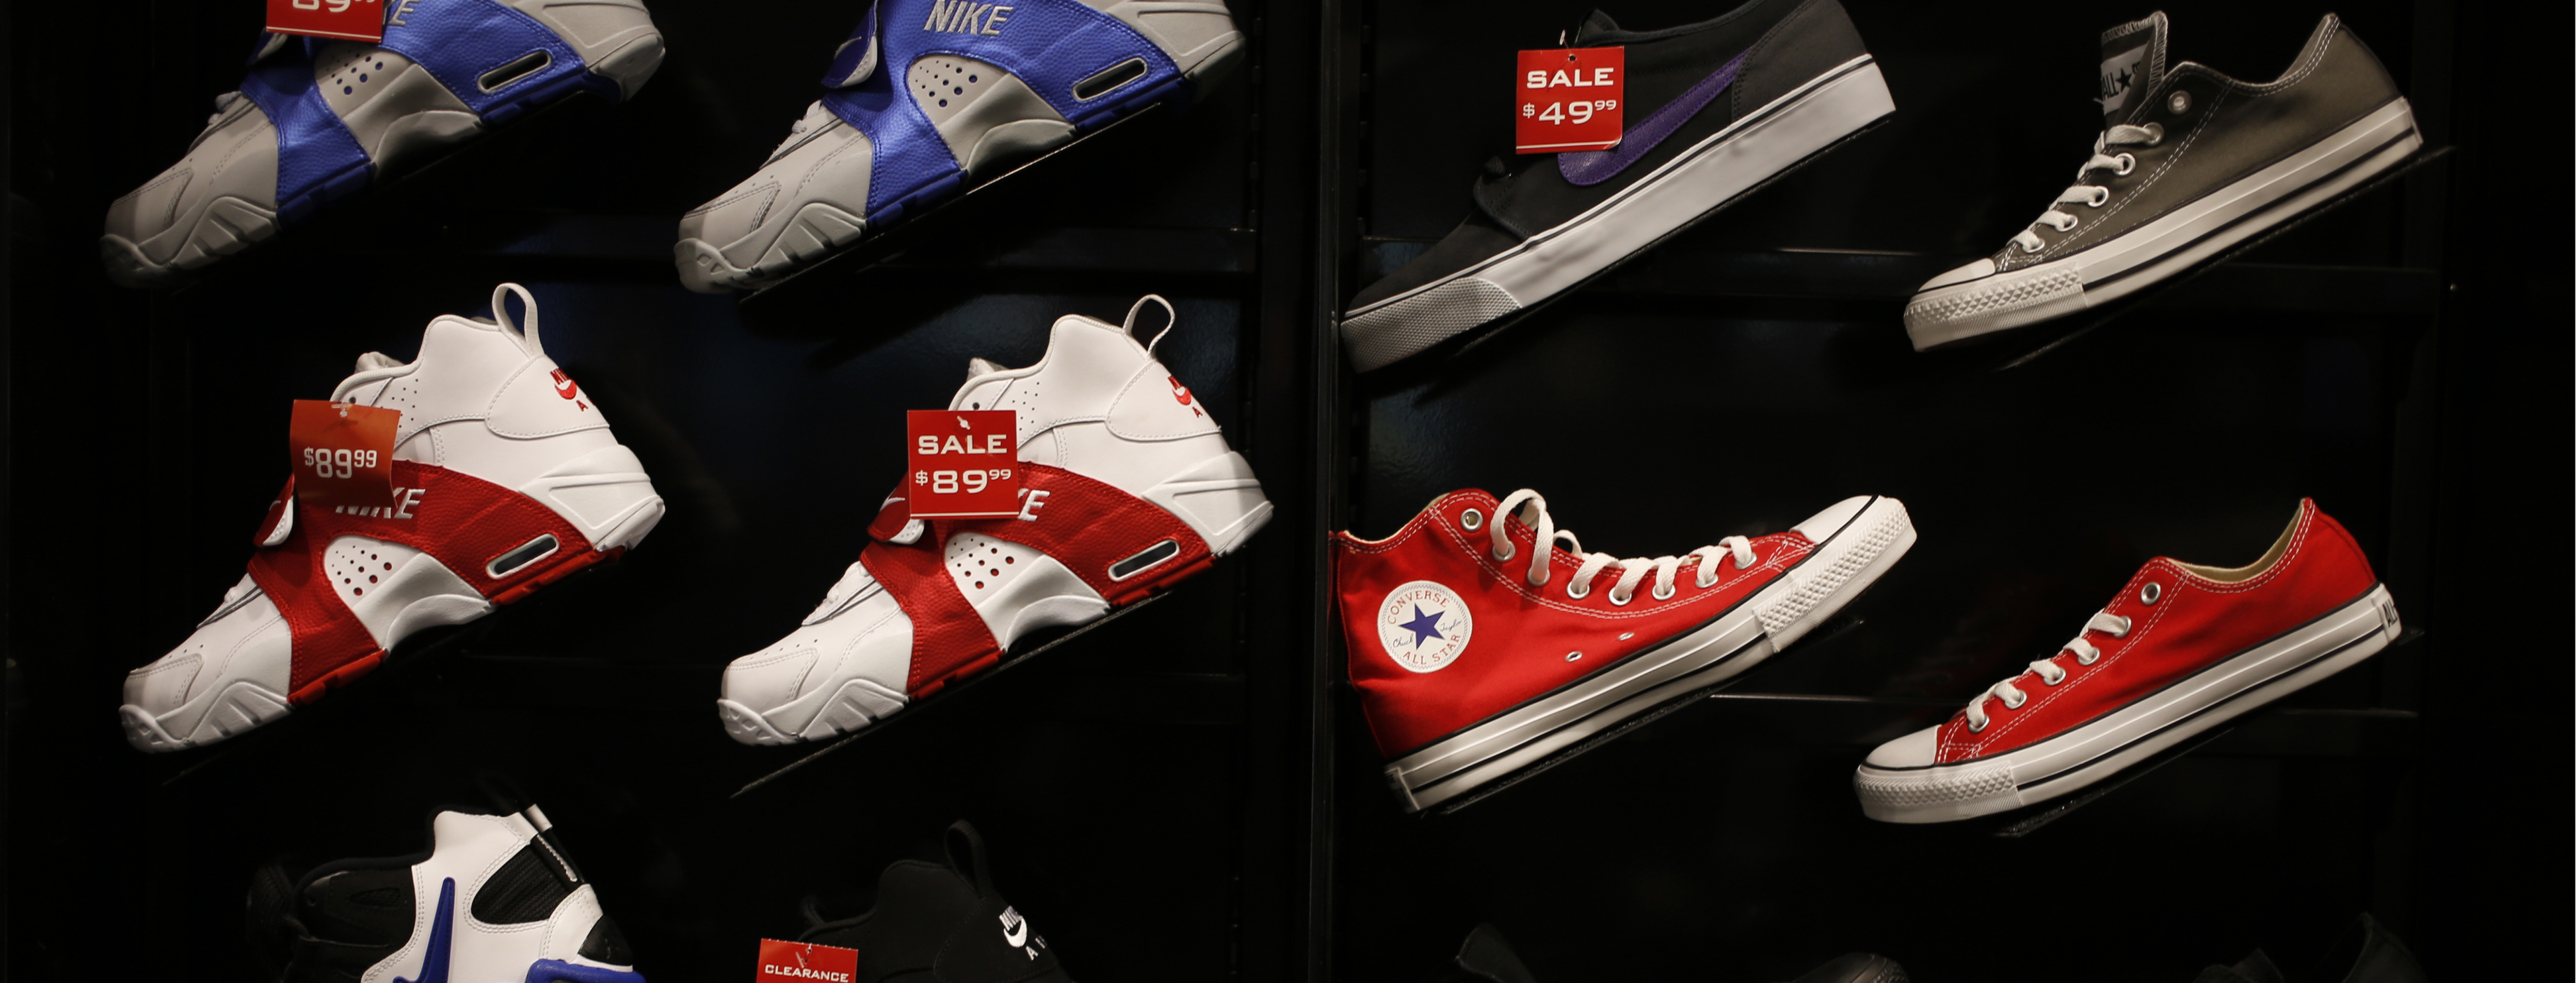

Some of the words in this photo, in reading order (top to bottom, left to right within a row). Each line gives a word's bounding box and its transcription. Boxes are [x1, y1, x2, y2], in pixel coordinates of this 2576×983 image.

[923, 0, 1014, 36] NIKE
[1527, 67, 1614, 89] SALE
[918, 435, 1008, 455] SALE
[1387, 590, 1450, 624] CONVERSE
[1393, 633, 1413, 648] Chuck
[1403, 651, 1427, 664] ALL
[1432, 634, 1461, 662] STAR
[765, 964, 849, 983] CLEARANCE
